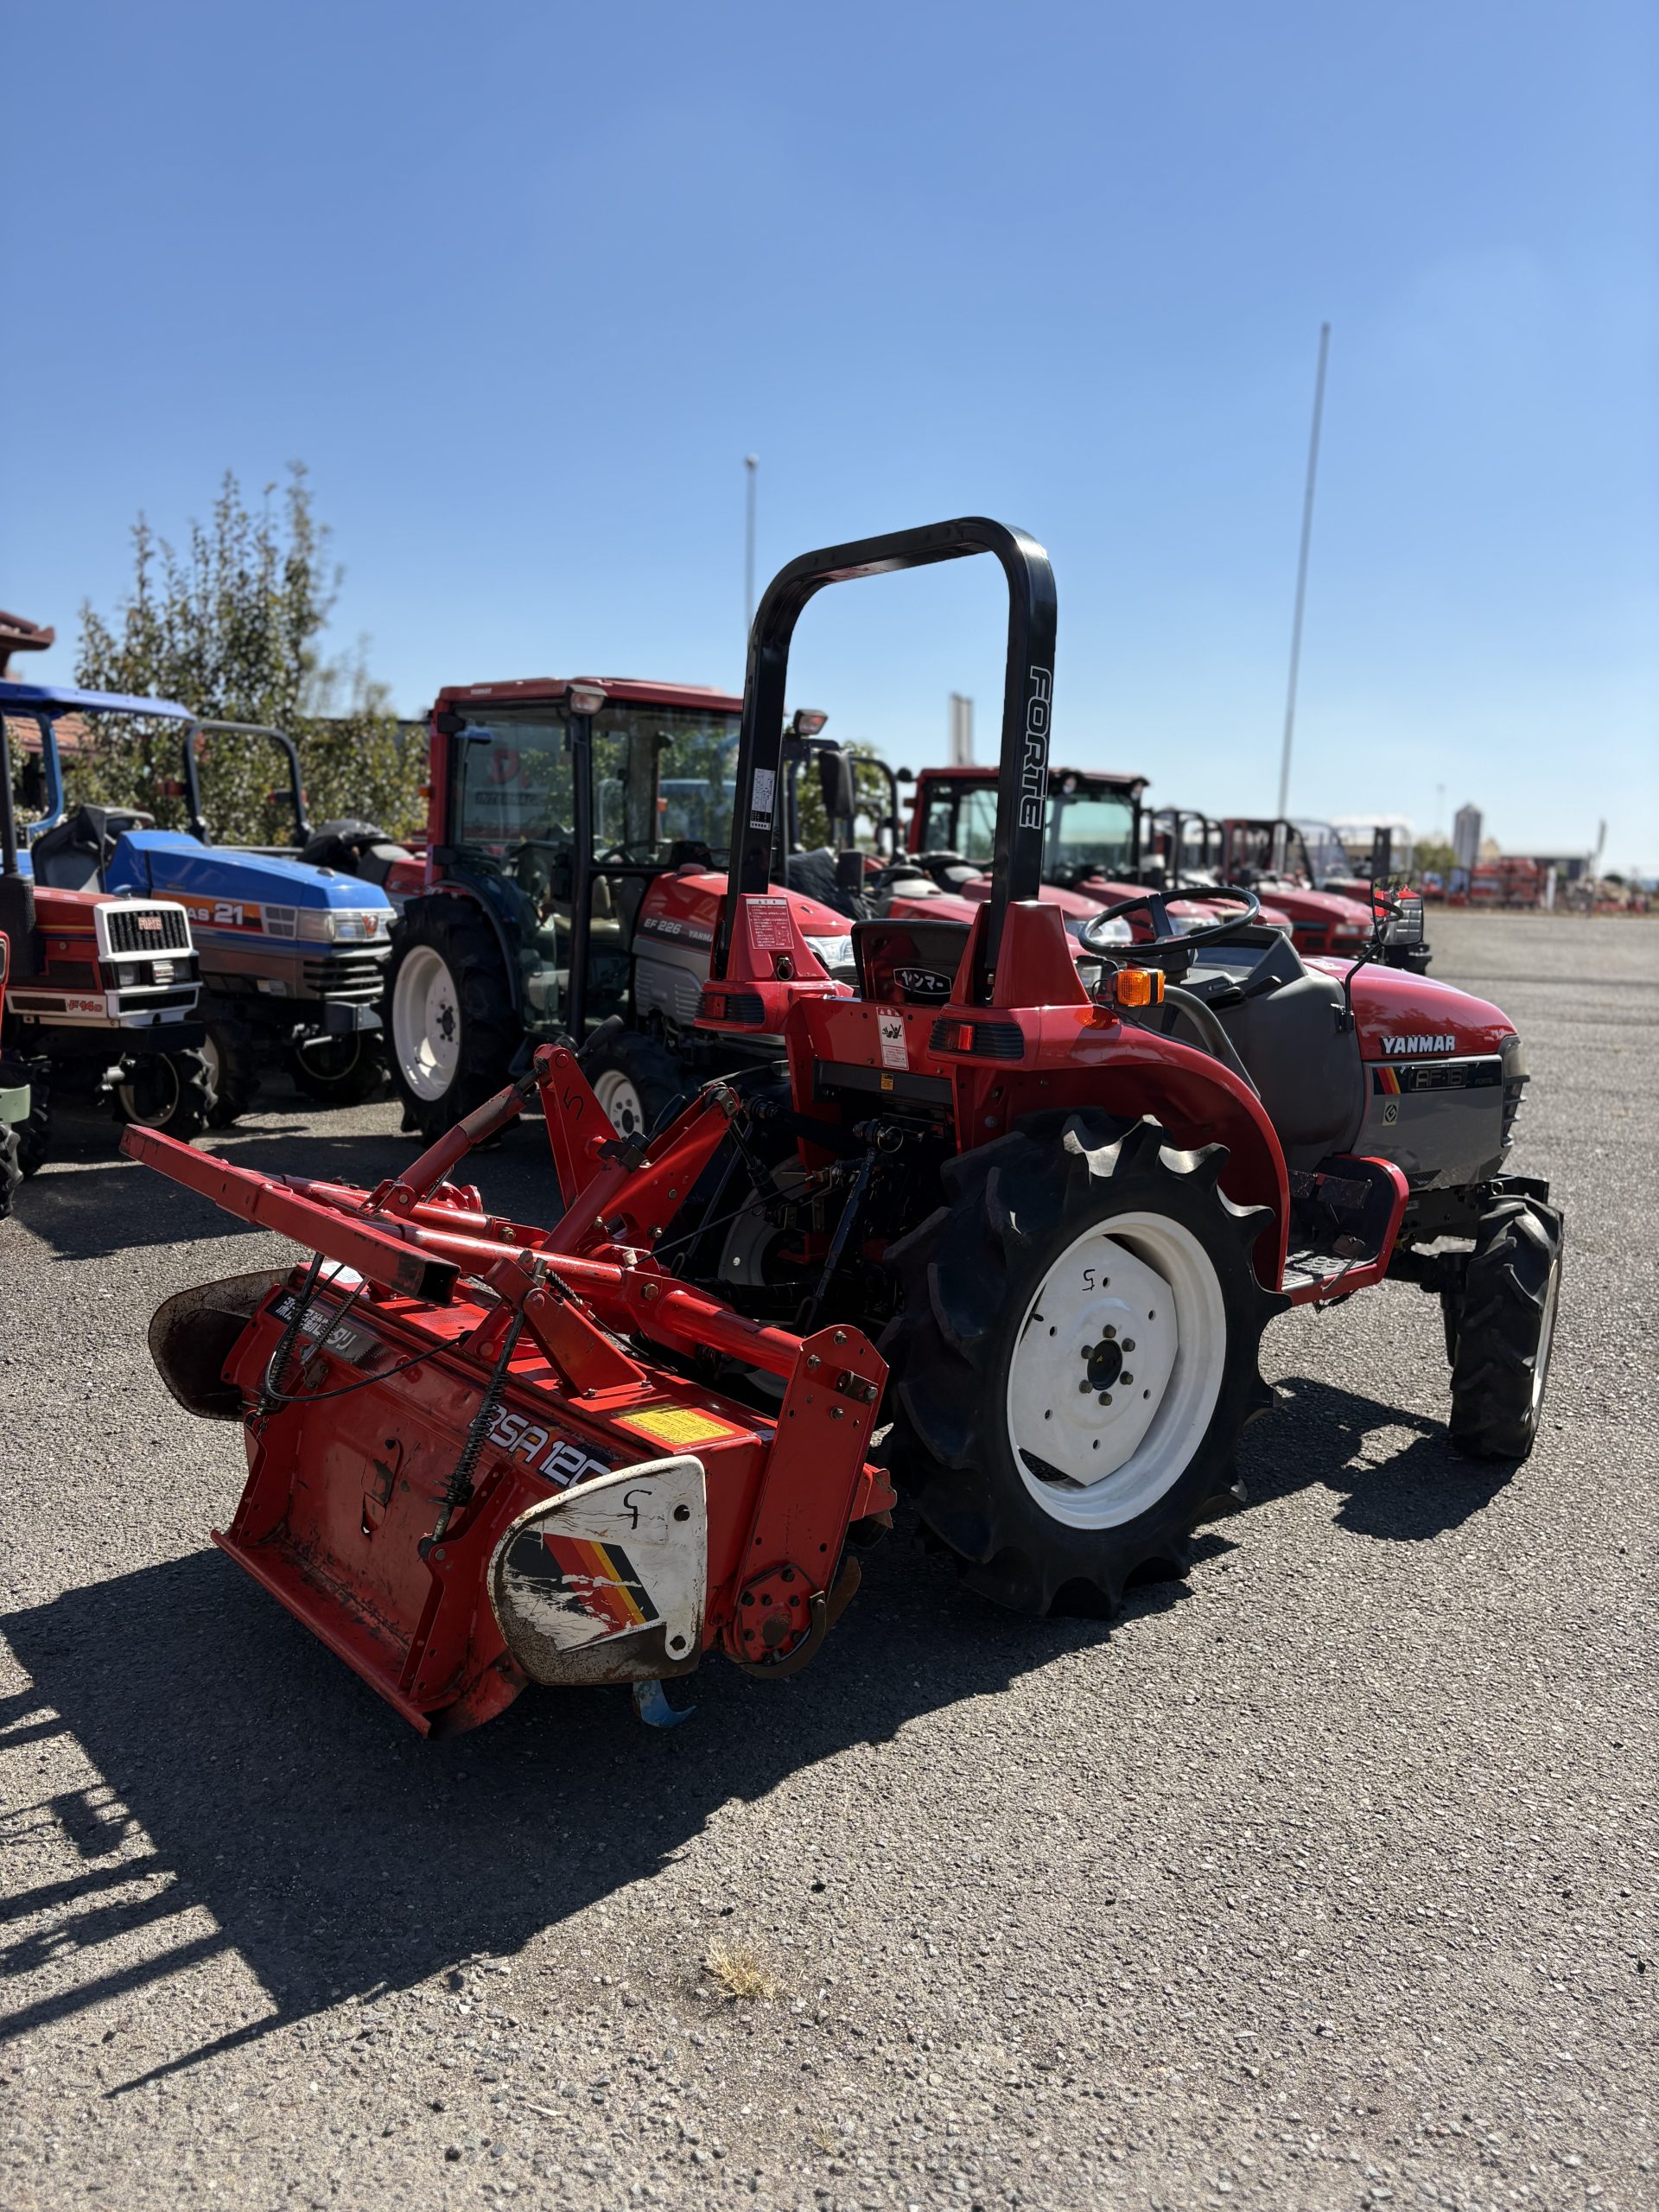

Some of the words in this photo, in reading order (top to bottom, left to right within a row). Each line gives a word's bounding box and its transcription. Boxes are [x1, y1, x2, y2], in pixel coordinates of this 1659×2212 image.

[1019, 664, 1052, 830] FORTE
[214, 903, 243, 925] 21
[644, 918, 658, 929] EF
[658, 920, 682, 934] 226
[689, 930, 713, 942] YANM
[901, 970, 944, 990] ヤンマー
[1382, 1035, 1456, 1054] YANMAR
